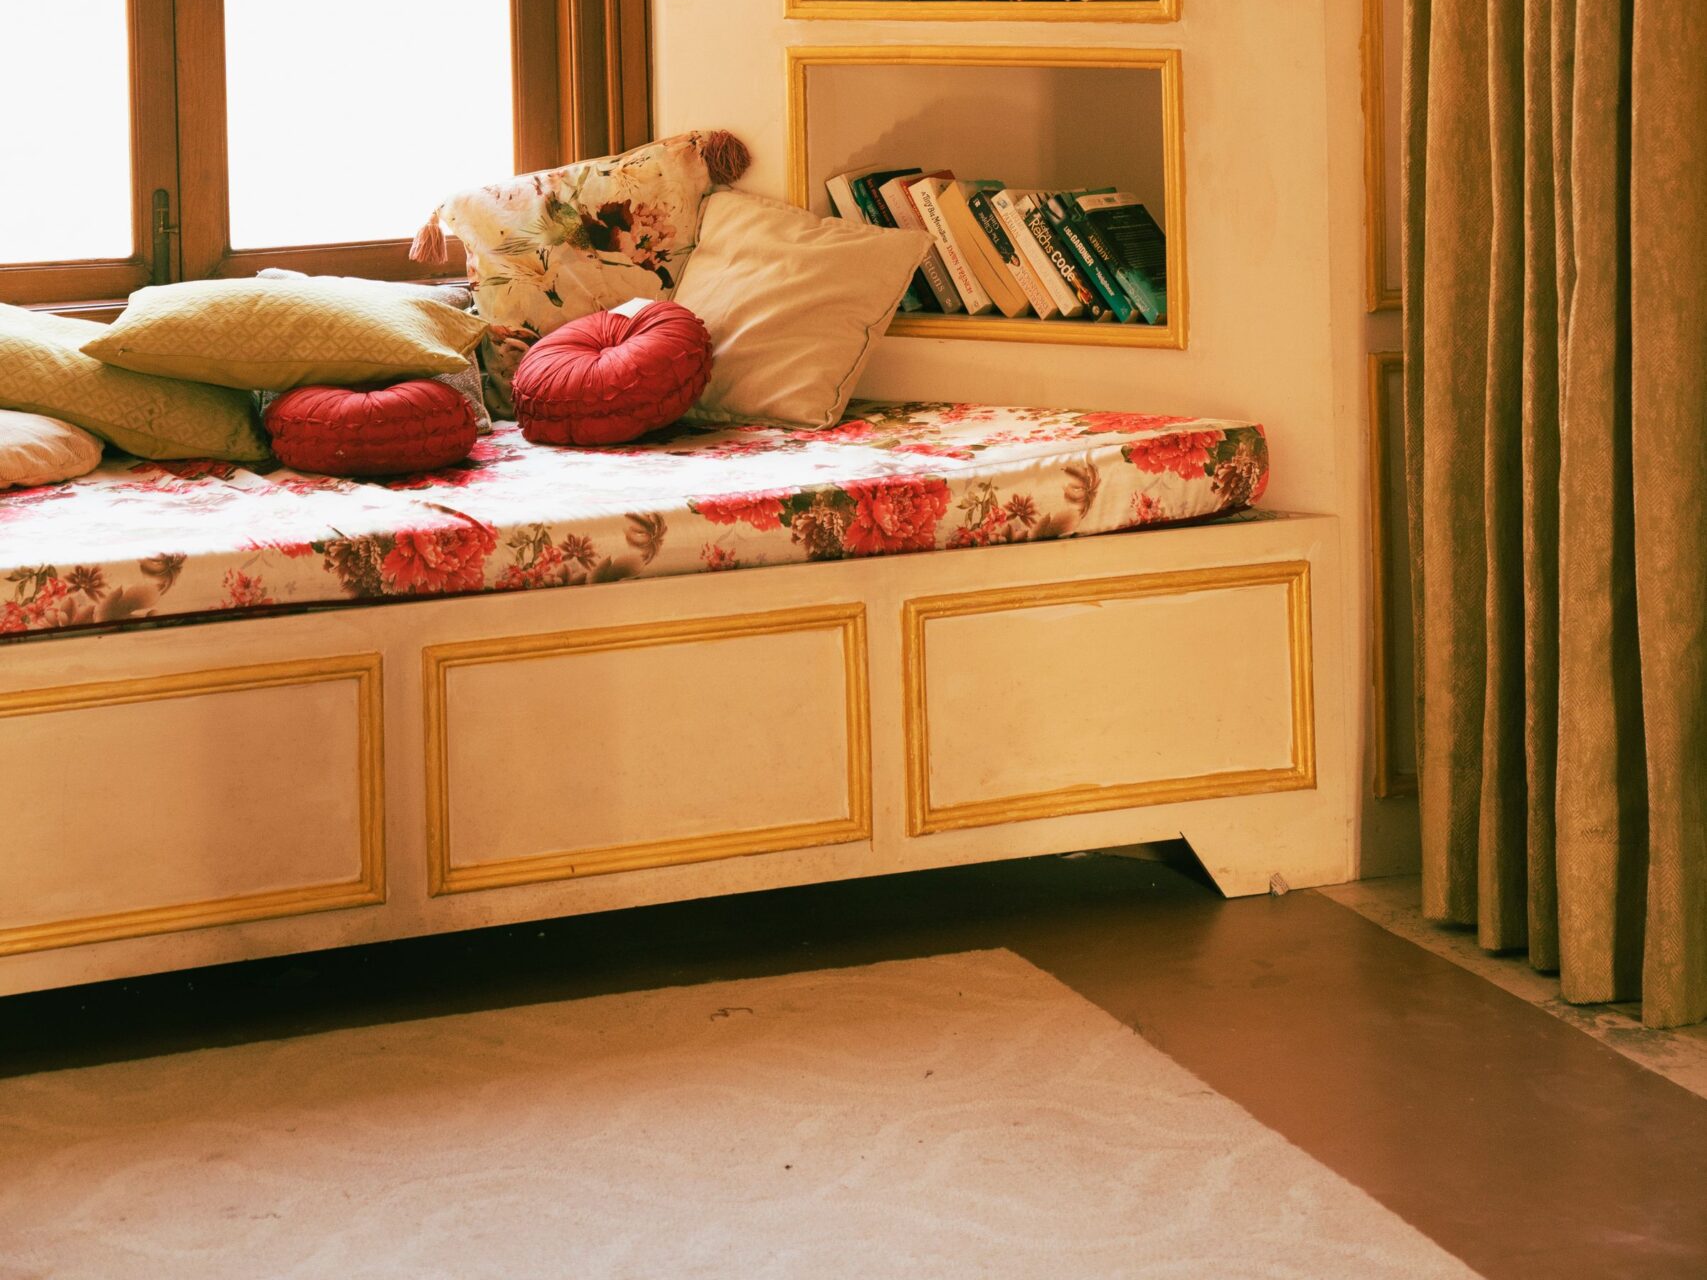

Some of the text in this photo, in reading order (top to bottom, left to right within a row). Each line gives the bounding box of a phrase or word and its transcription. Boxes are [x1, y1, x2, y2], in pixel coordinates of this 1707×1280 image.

[920, 193, 933, 208] Tiny
[932, 216, 949, 244] Marvellous
[986, 213, 1001, 231] Girls
[989, 231, 1000, 243] The
[1026, 216, 1080, 284] Reichs code
[1062, 225, 1095, 267] LISA GARDNER
[1086, 233, 1110, 262] AUDREY
[945, 244, 973, 295] DAWN FRENCH
